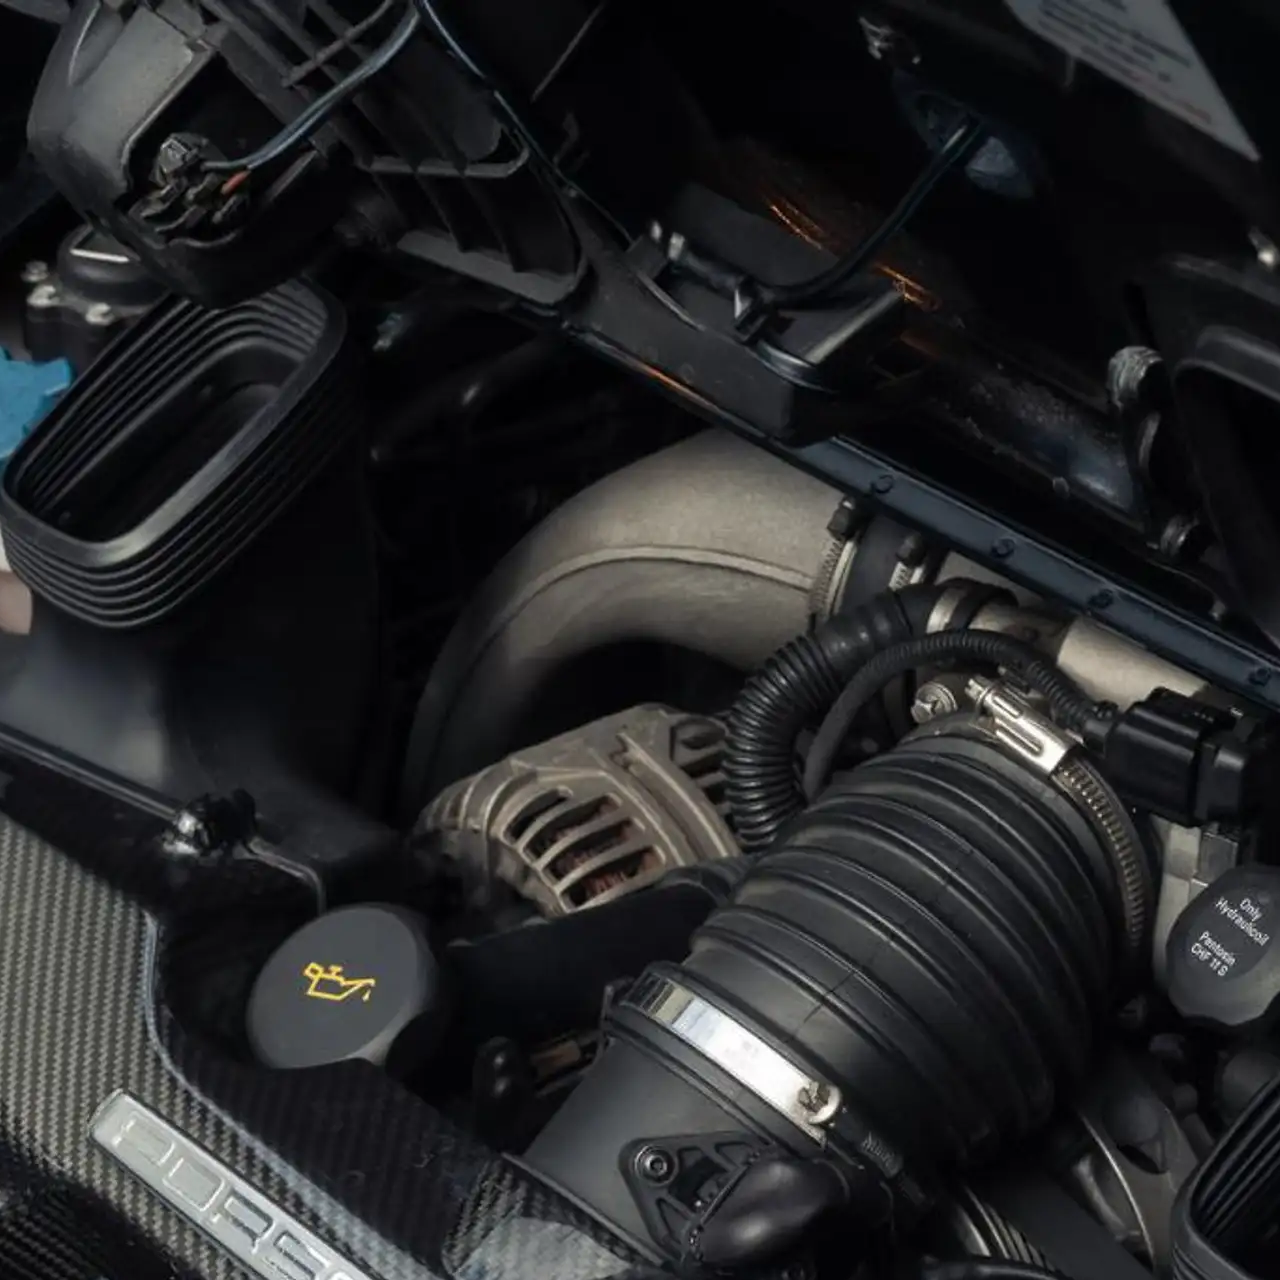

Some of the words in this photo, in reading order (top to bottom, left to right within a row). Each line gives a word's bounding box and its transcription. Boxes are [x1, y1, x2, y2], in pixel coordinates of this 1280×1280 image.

[1239, 897, 1262, 922] Only
[1191, 942, 1212, 961] CHF
[1217, 964, 1229, 976] S
